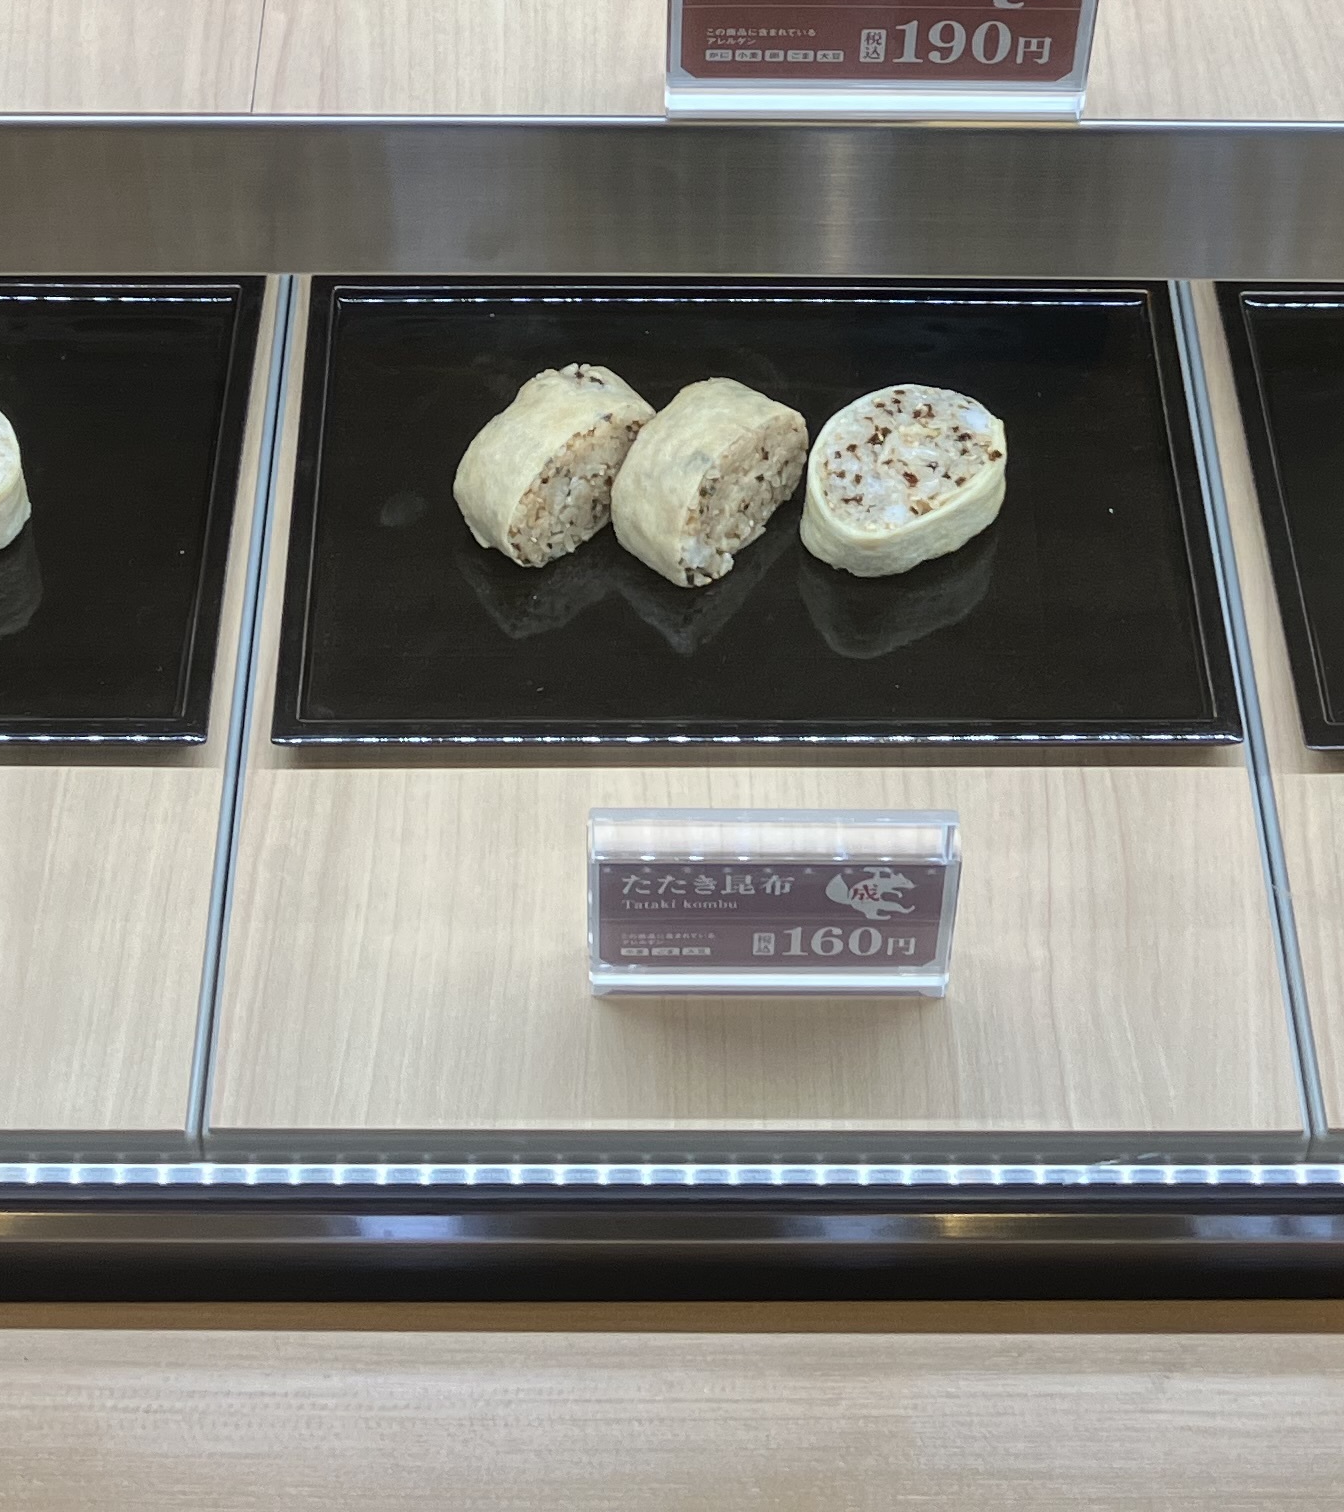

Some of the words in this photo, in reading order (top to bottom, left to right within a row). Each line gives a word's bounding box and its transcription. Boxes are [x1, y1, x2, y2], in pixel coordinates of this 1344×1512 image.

[863, 31, 884, 60] 税込
[892, 20, 1053, 64] 190円
[622, 874, 795, 895] たたき昆布
[622, 900, 677, 910] Tataki
[782, 926, 916, 956] 160円
